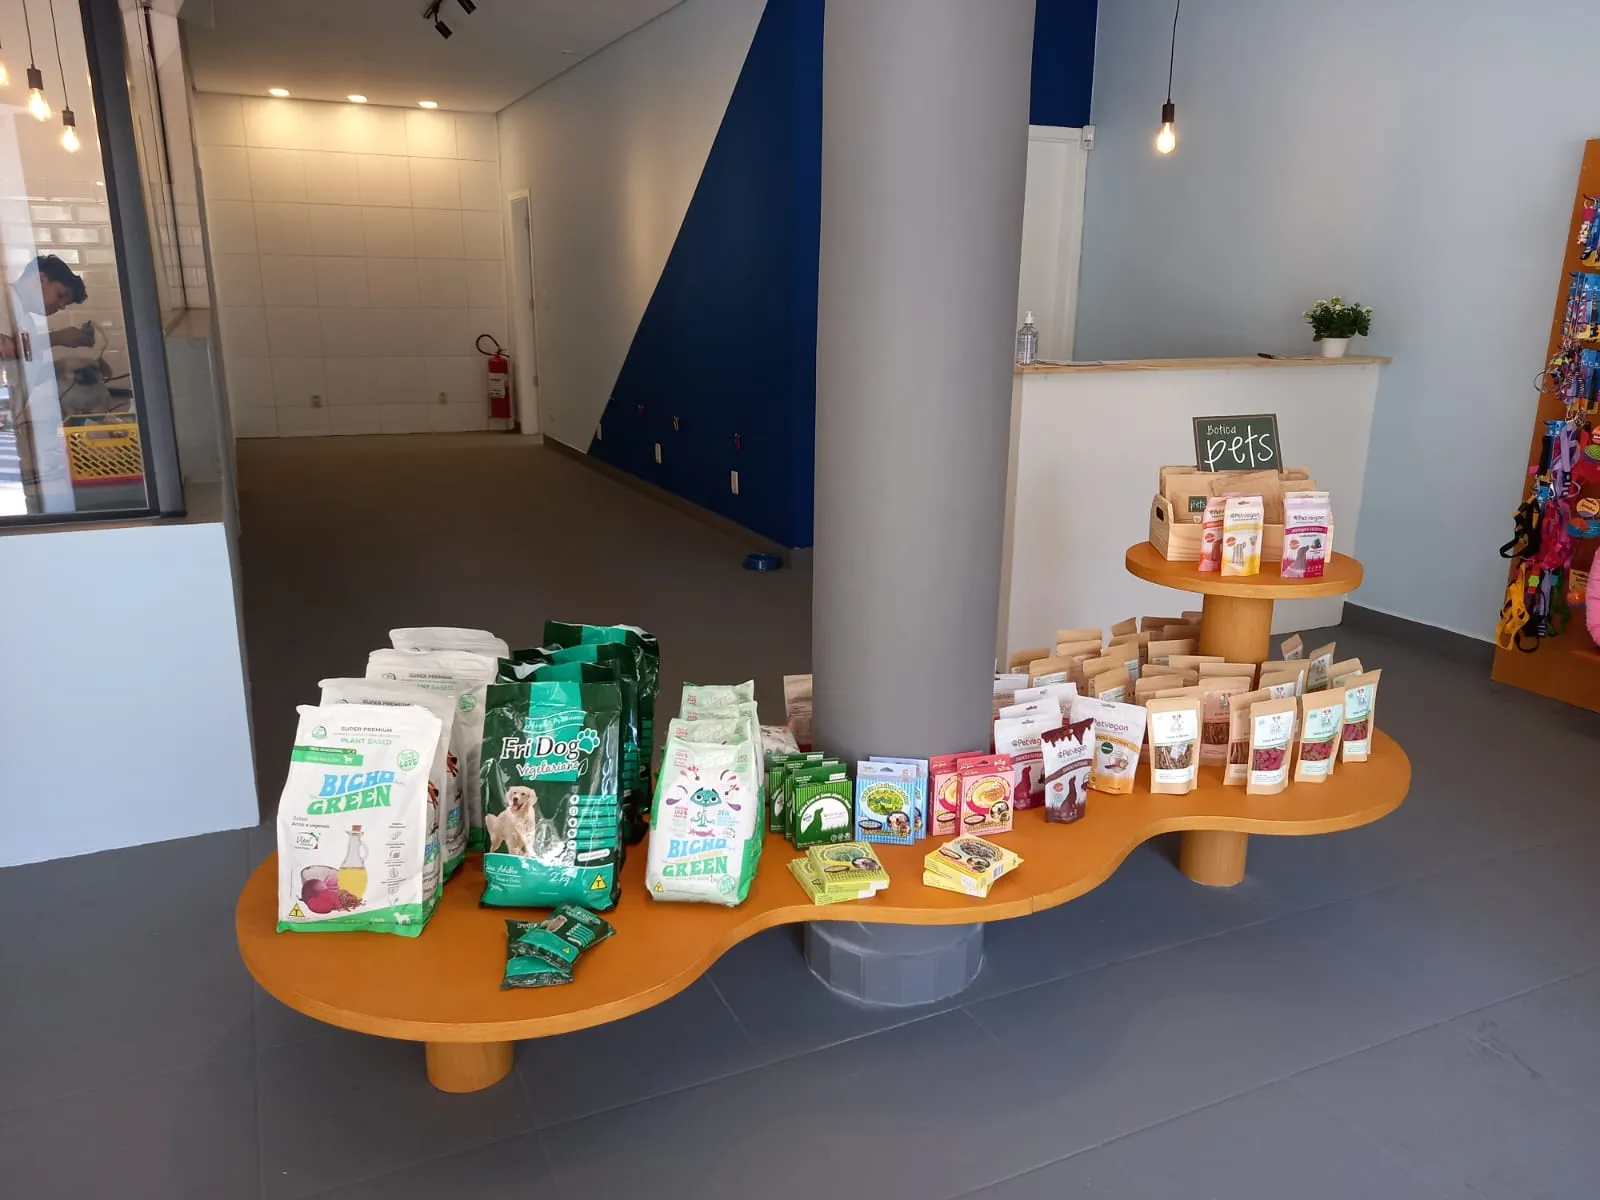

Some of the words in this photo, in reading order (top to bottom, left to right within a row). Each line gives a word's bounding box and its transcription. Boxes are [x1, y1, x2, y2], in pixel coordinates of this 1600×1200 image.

[1206, 424, 1238, 435] Botica
[1203, 424, 1274, 473] pets
[501, 737, 533, 759] Fri
[535, 735, 580, 761] Dog
[1062, 744, 1087, 758] Petvegan
[319, 770, 396, 798] BICHO
[306, 784, 393, 816] GREEN
[667, 838, 728, 858] BICHO
[662, 856, 728, 877] GREEN
